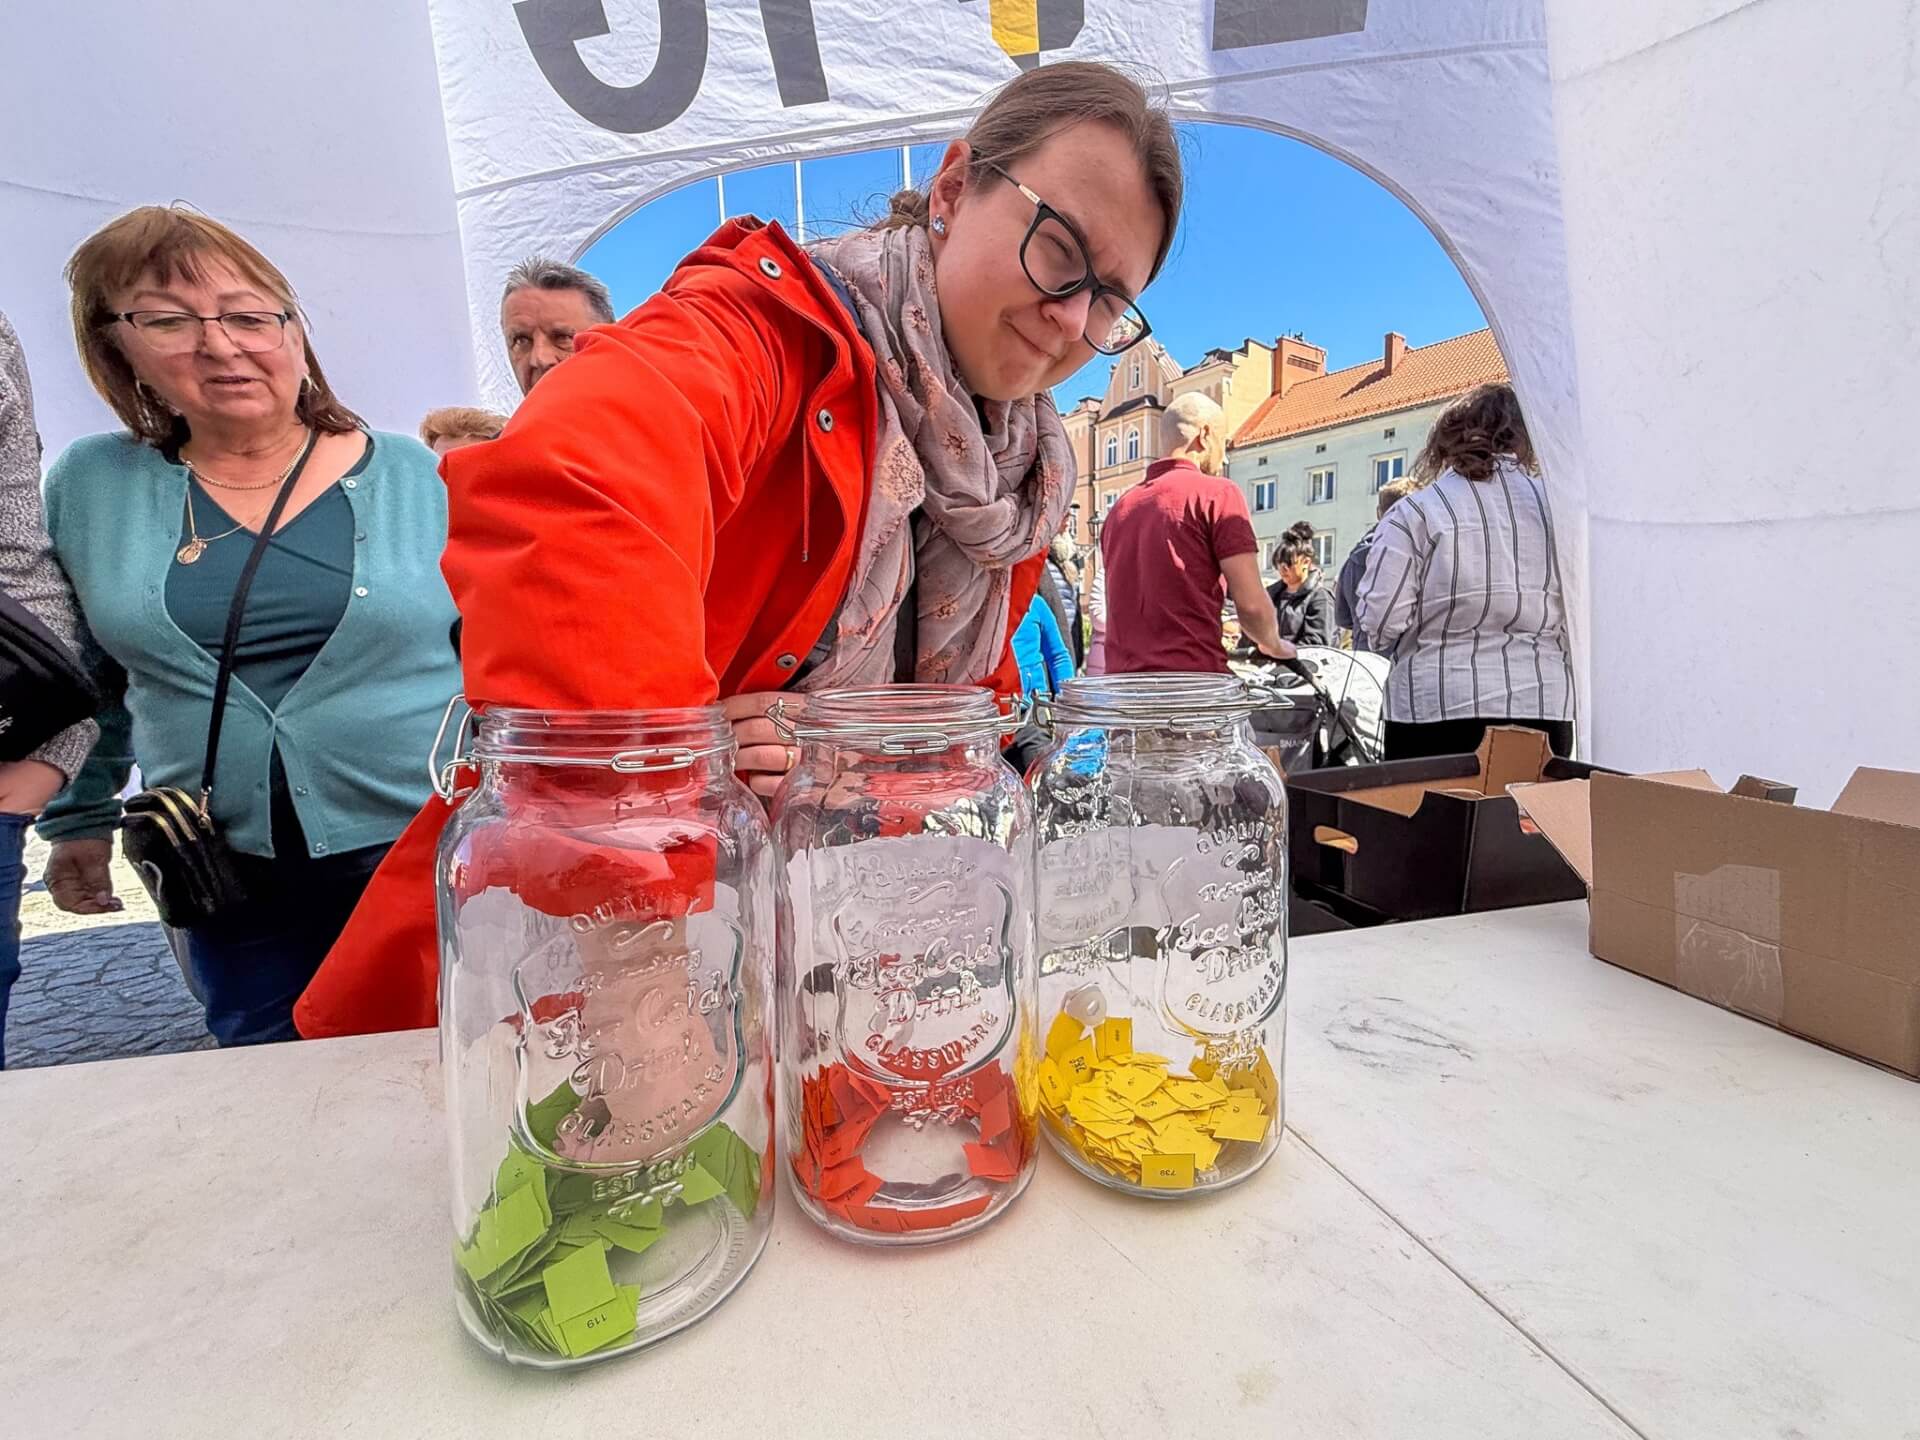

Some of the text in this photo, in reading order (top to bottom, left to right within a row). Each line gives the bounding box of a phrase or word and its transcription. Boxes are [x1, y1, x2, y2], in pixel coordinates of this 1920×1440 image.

[924, 926, 995, 978] Cold
[865, 1008, 998, 1069] GLASSWARE
[592, 1170, 640, 1200] EST
[586, 1312, 607, 1329] 119
